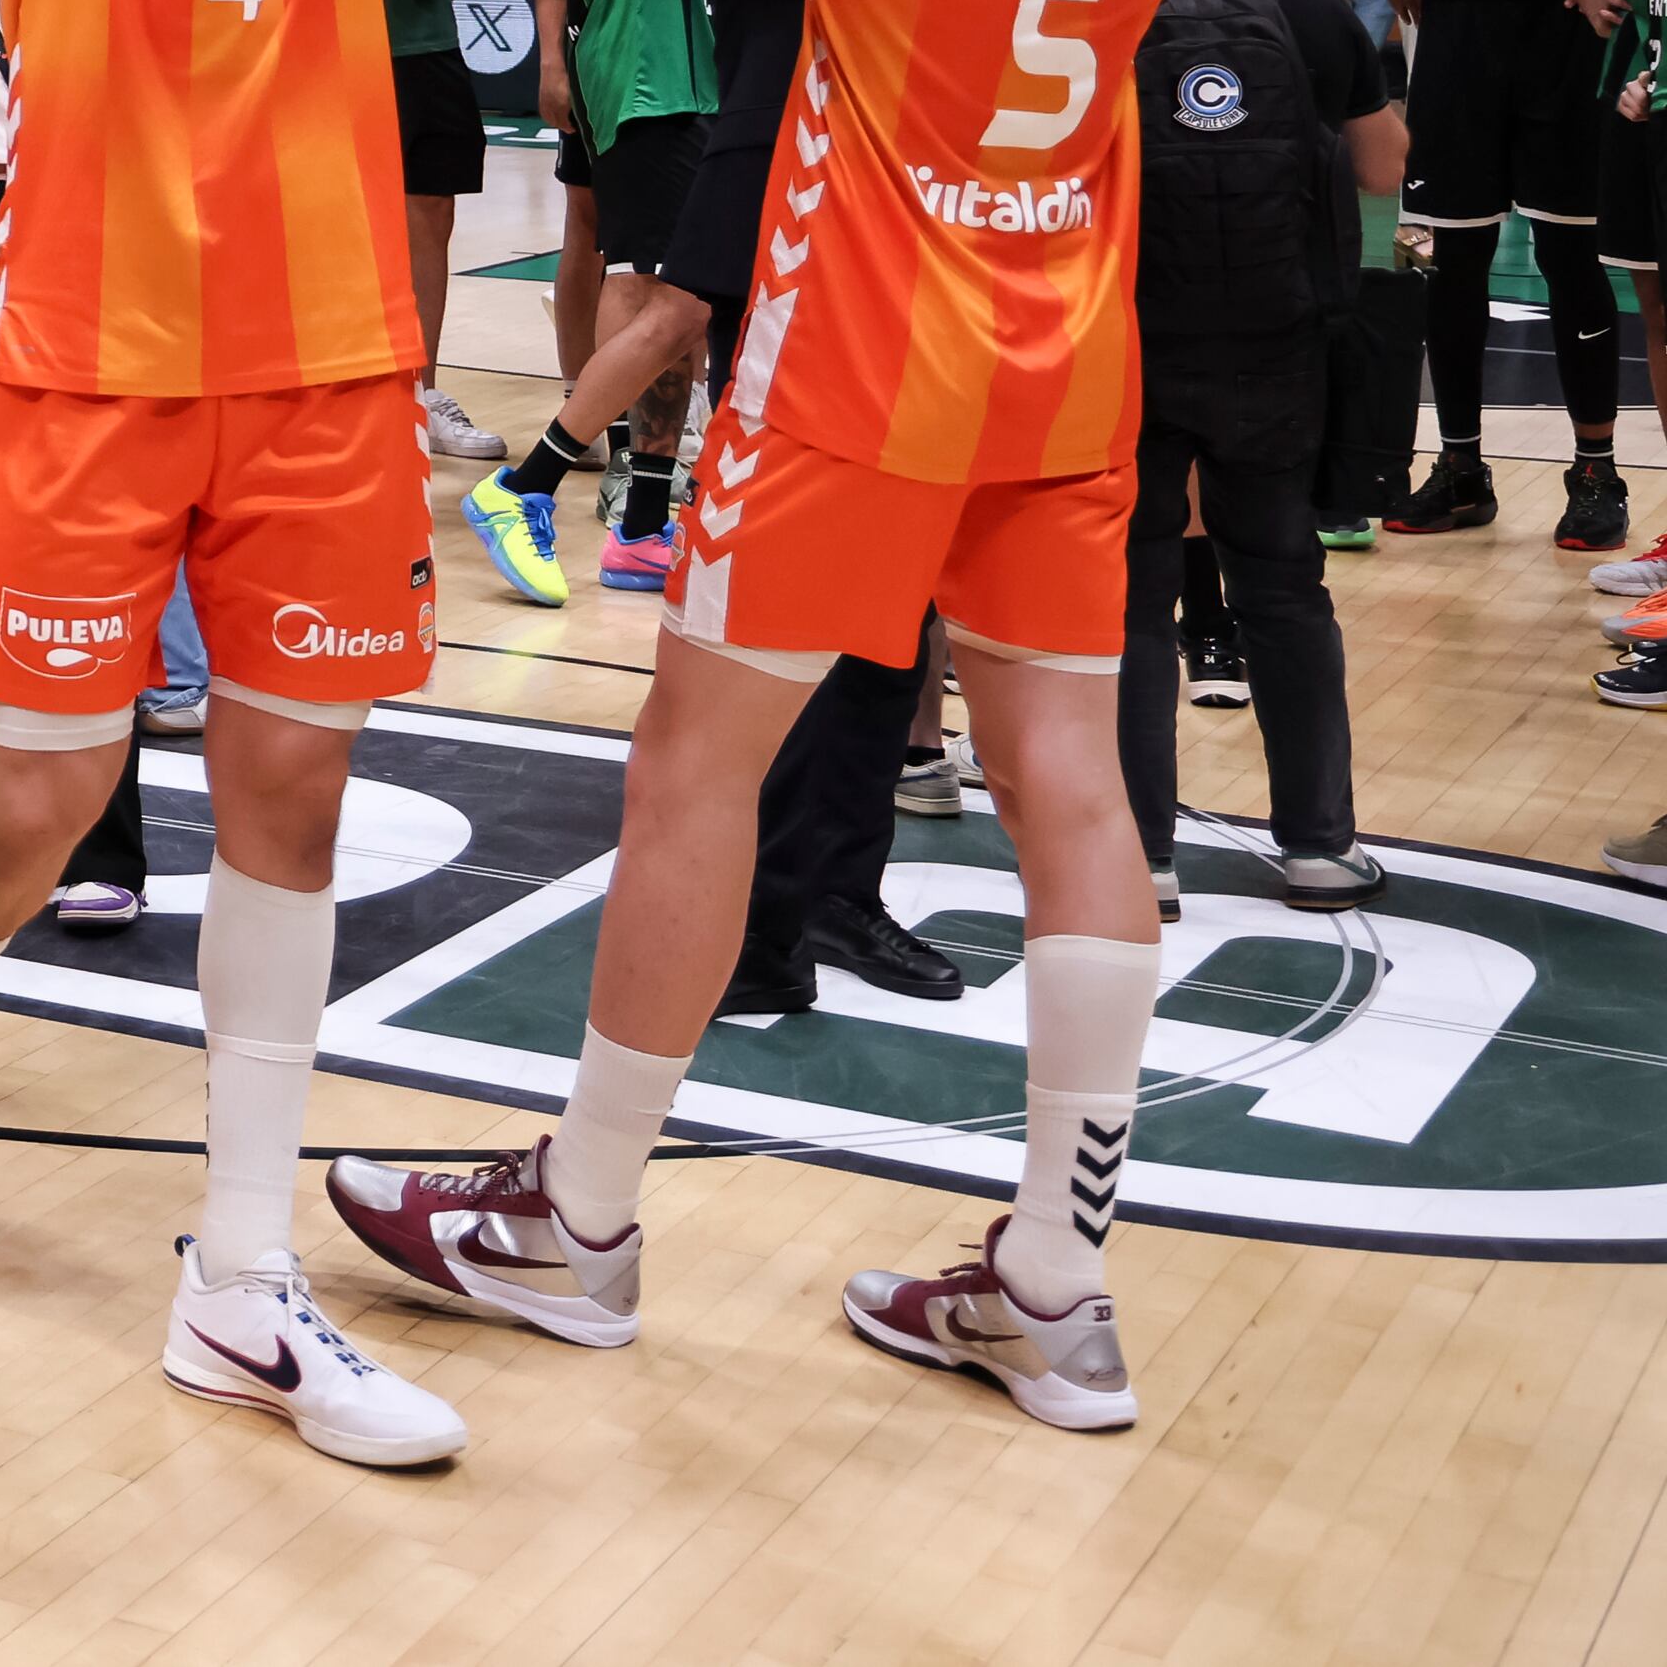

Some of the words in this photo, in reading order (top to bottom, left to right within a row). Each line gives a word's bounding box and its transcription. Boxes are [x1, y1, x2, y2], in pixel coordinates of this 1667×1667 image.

[1180, 110, 1219, 128] CAPSULE
[7, 608, 124, 643] PULEVA
[297, 623, 404, 657] Midea
